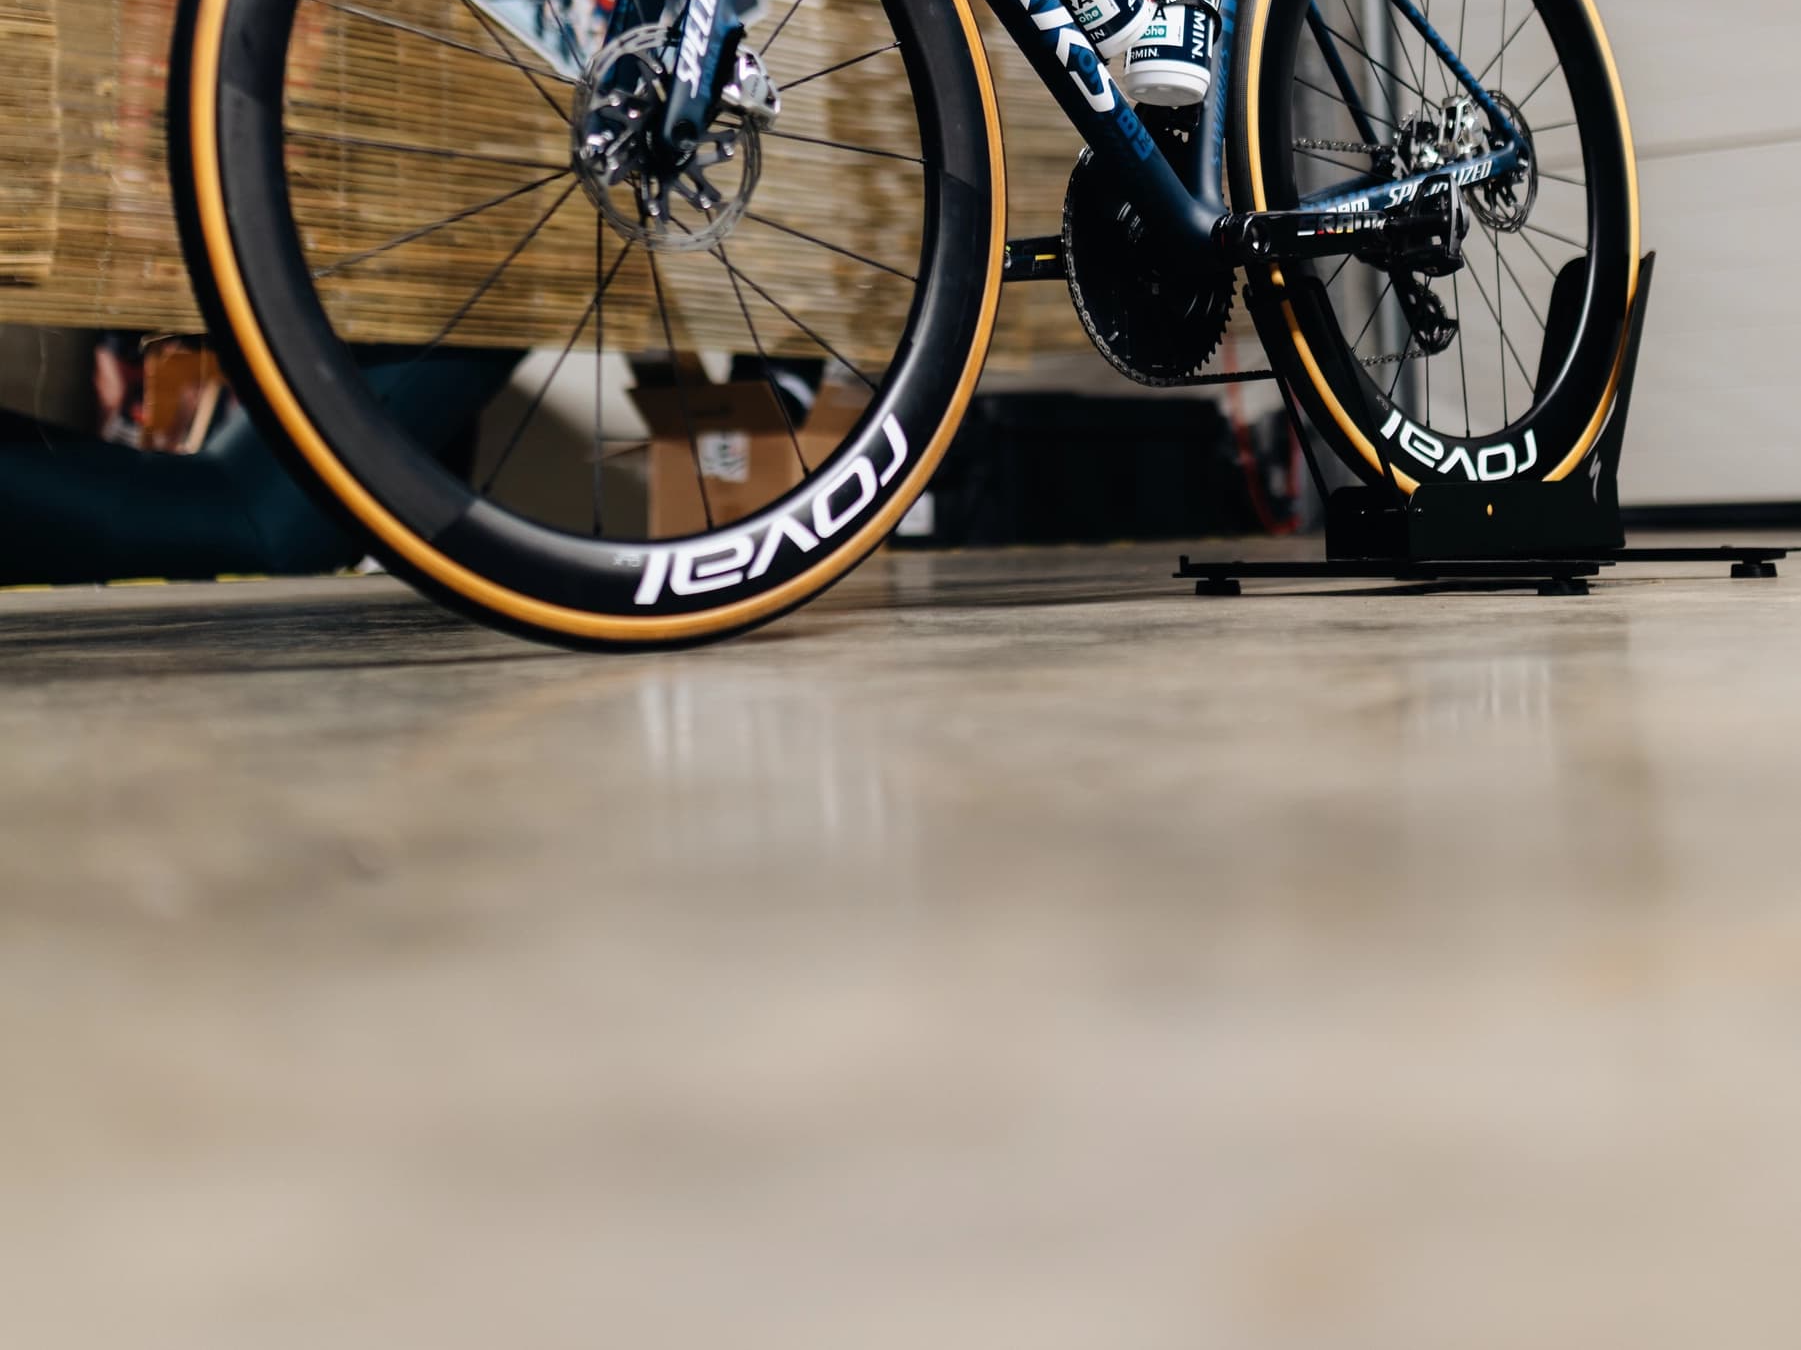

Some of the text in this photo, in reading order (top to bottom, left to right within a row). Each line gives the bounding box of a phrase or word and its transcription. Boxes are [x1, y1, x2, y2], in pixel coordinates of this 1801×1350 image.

[1384, 160, 1493, 209] SPIAIZED
[1380, 409, 1538, 482] roval
[633, 413, 908, 606] roval
